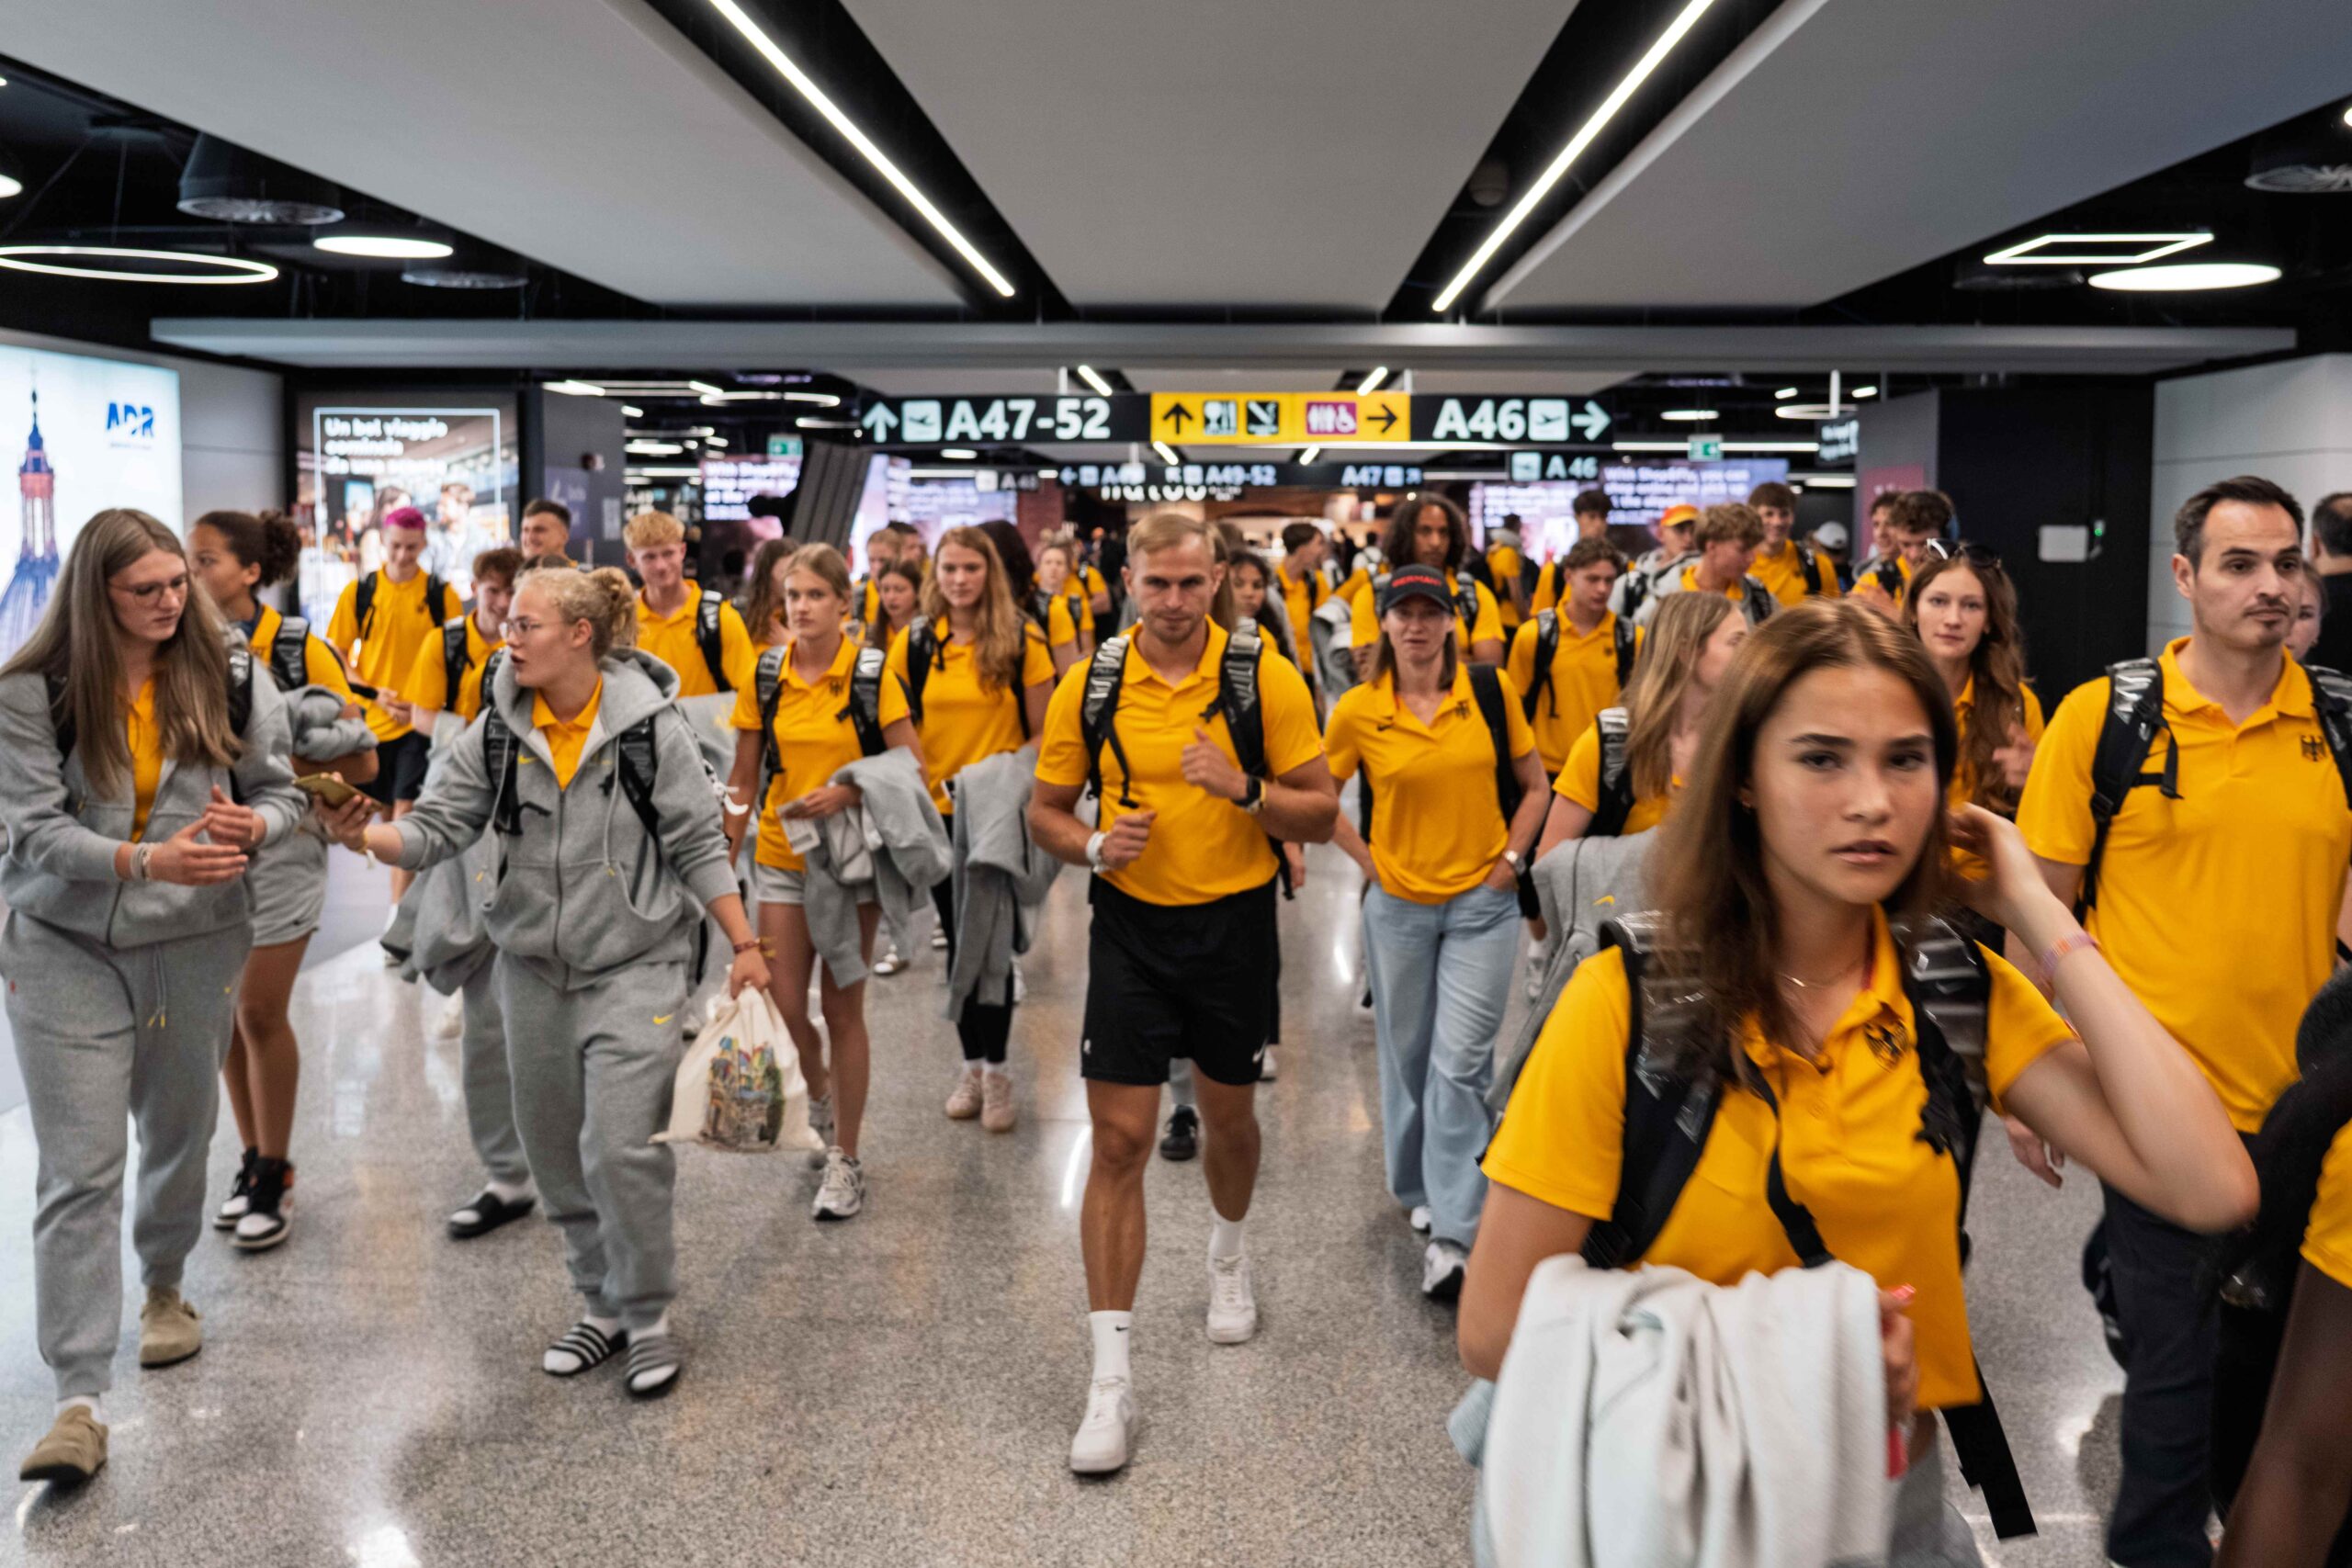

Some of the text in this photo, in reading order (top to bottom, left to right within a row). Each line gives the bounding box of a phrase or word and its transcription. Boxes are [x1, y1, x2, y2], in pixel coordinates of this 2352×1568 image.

[107, 402, 154, 437] ADR
[324, 417, 351, 437] Un
[383, 417, 448, 442] viaggio
[944, 399, 1111, 441] A47-52
[1432, 399, 1526, 441] A46
[1340, 465, 1383, 486] A47
